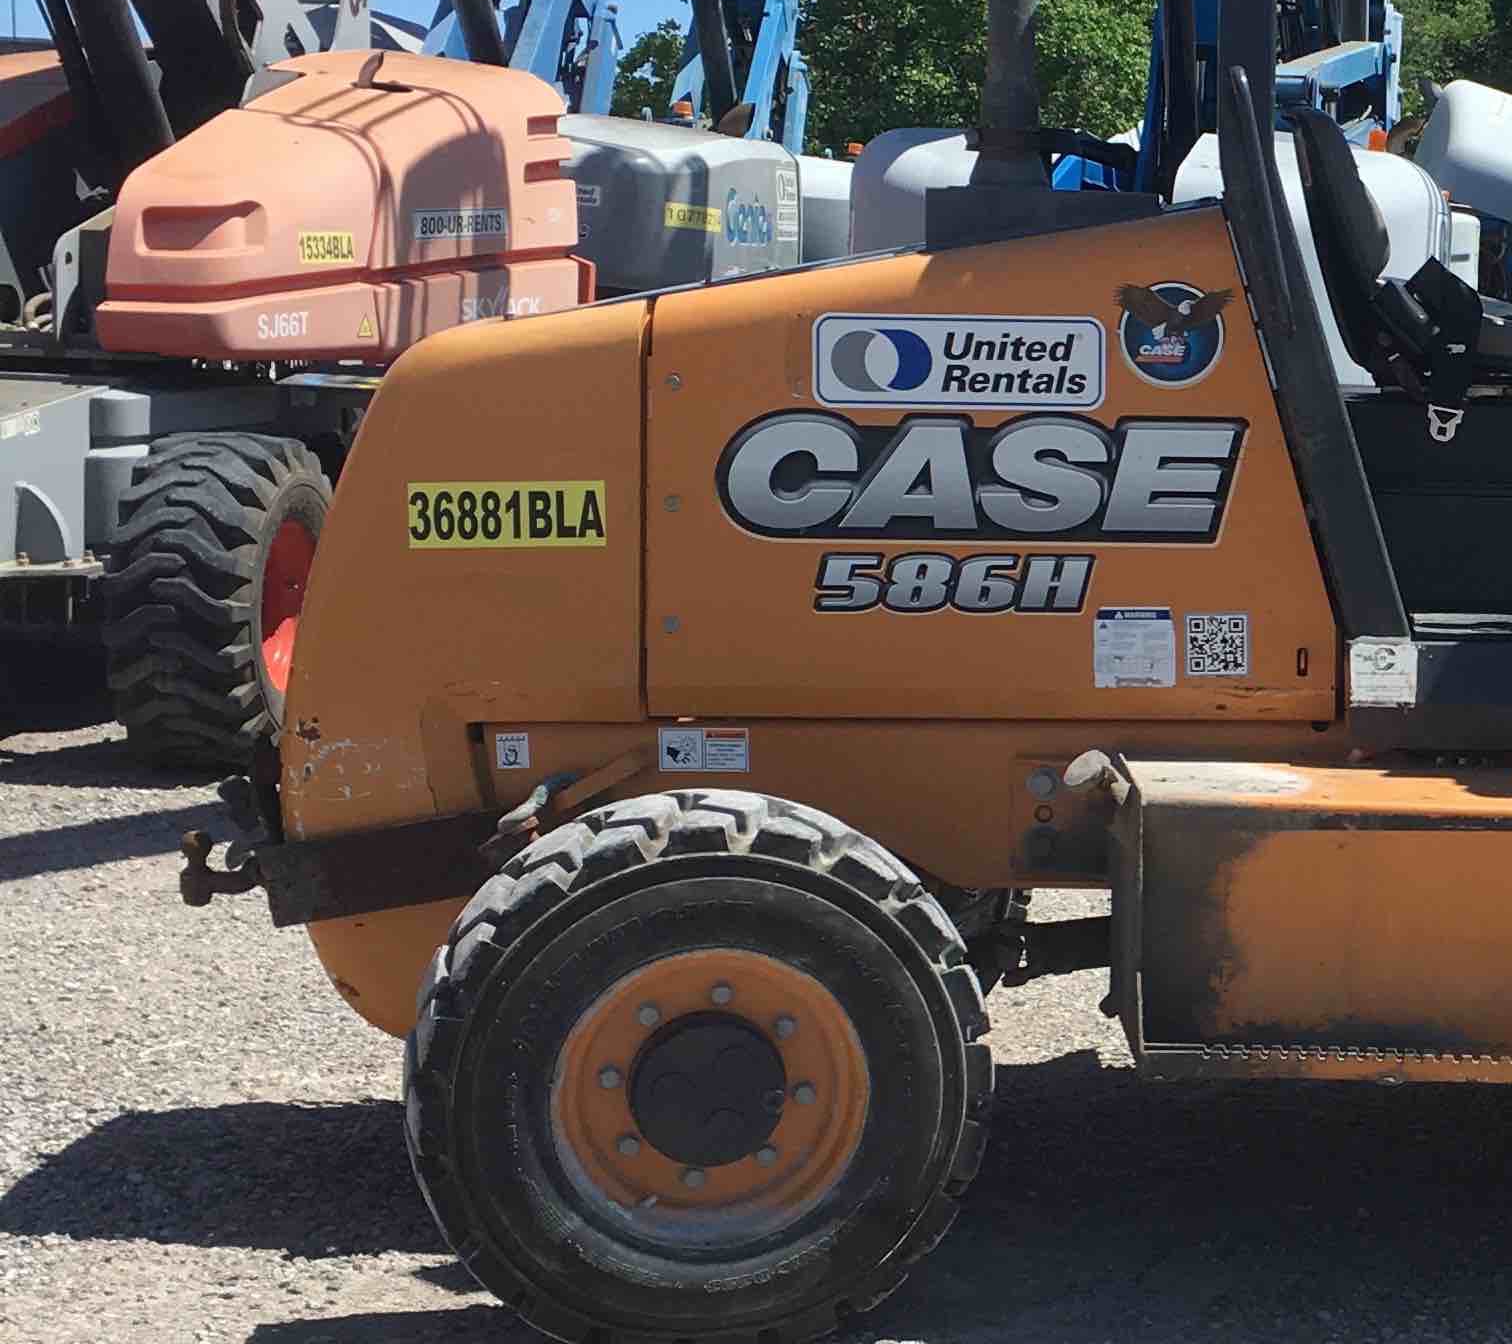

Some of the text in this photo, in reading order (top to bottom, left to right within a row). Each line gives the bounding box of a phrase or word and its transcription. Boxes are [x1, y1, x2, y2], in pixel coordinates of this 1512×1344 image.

[420, 212, 503, 235] 800-UR-RENTS
[299, 234, 354, 262] 15334BLA
[256, 310, 310, 339] SJ66T
[943, 330, 1076, 362] United
[1138, 343, 1187, 357] CASE
[940, 364, 1088, 395] Rentals
[725, 417, 1239, 535] CASE
[408, 489, 606, 541] 36881BLA
[814, 553, 1095, 612] 586H
